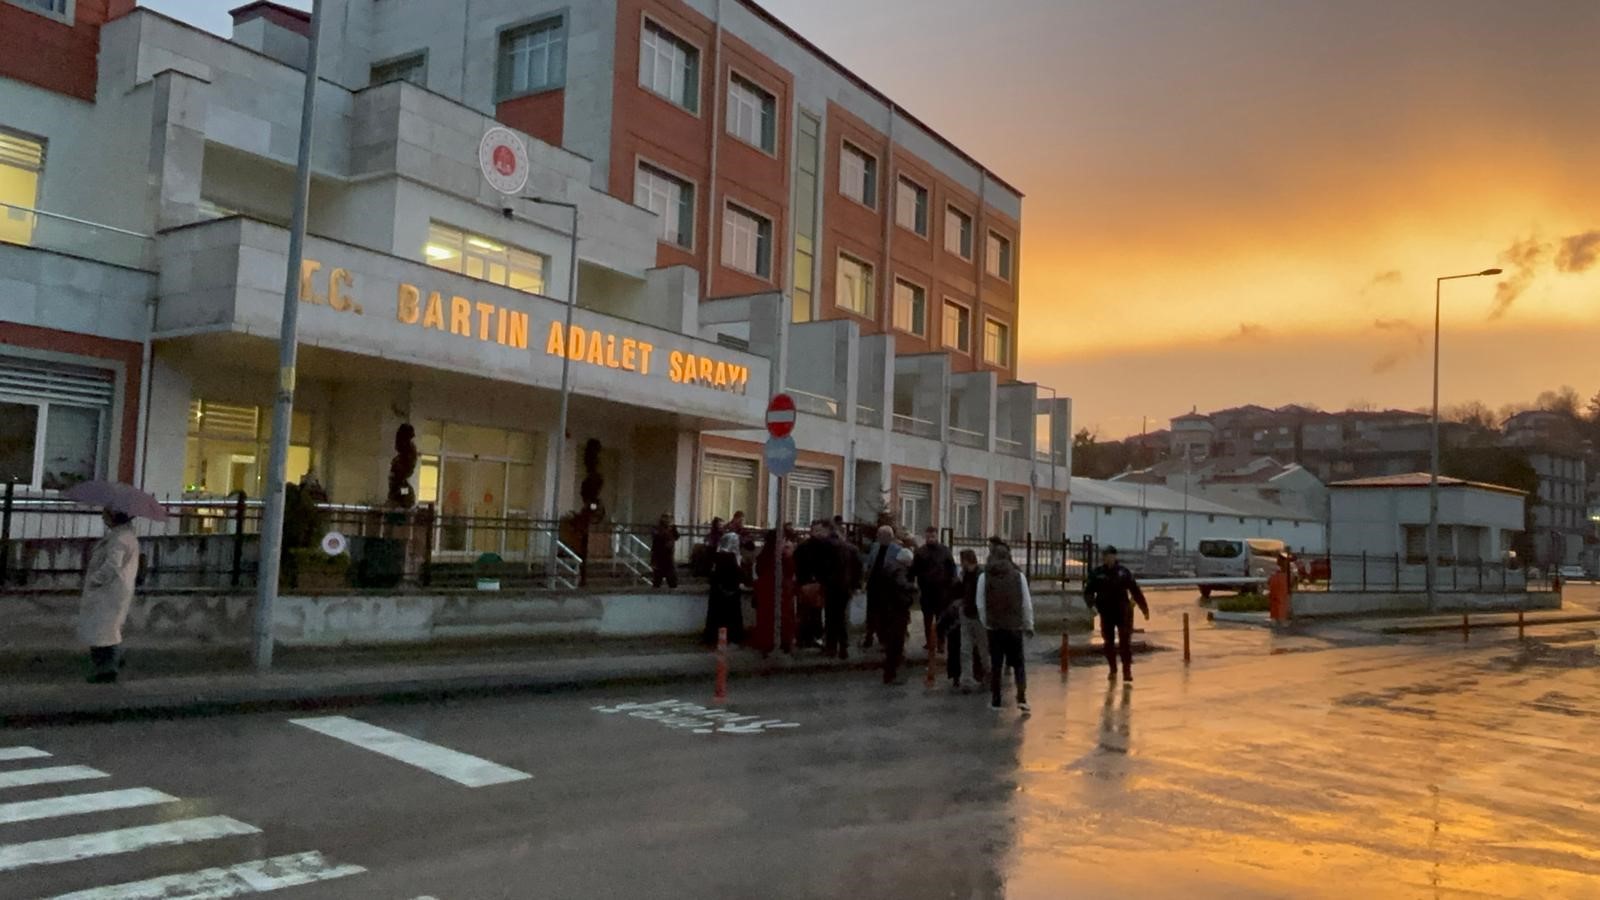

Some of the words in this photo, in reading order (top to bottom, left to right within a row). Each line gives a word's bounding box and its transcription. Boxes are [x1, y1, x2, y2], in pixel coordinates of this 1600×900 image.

[397, 283, 529, 349] BARTIN
[546, 320, 653, 375] ADALET
[669, 350, 748, 395] SARAYI
